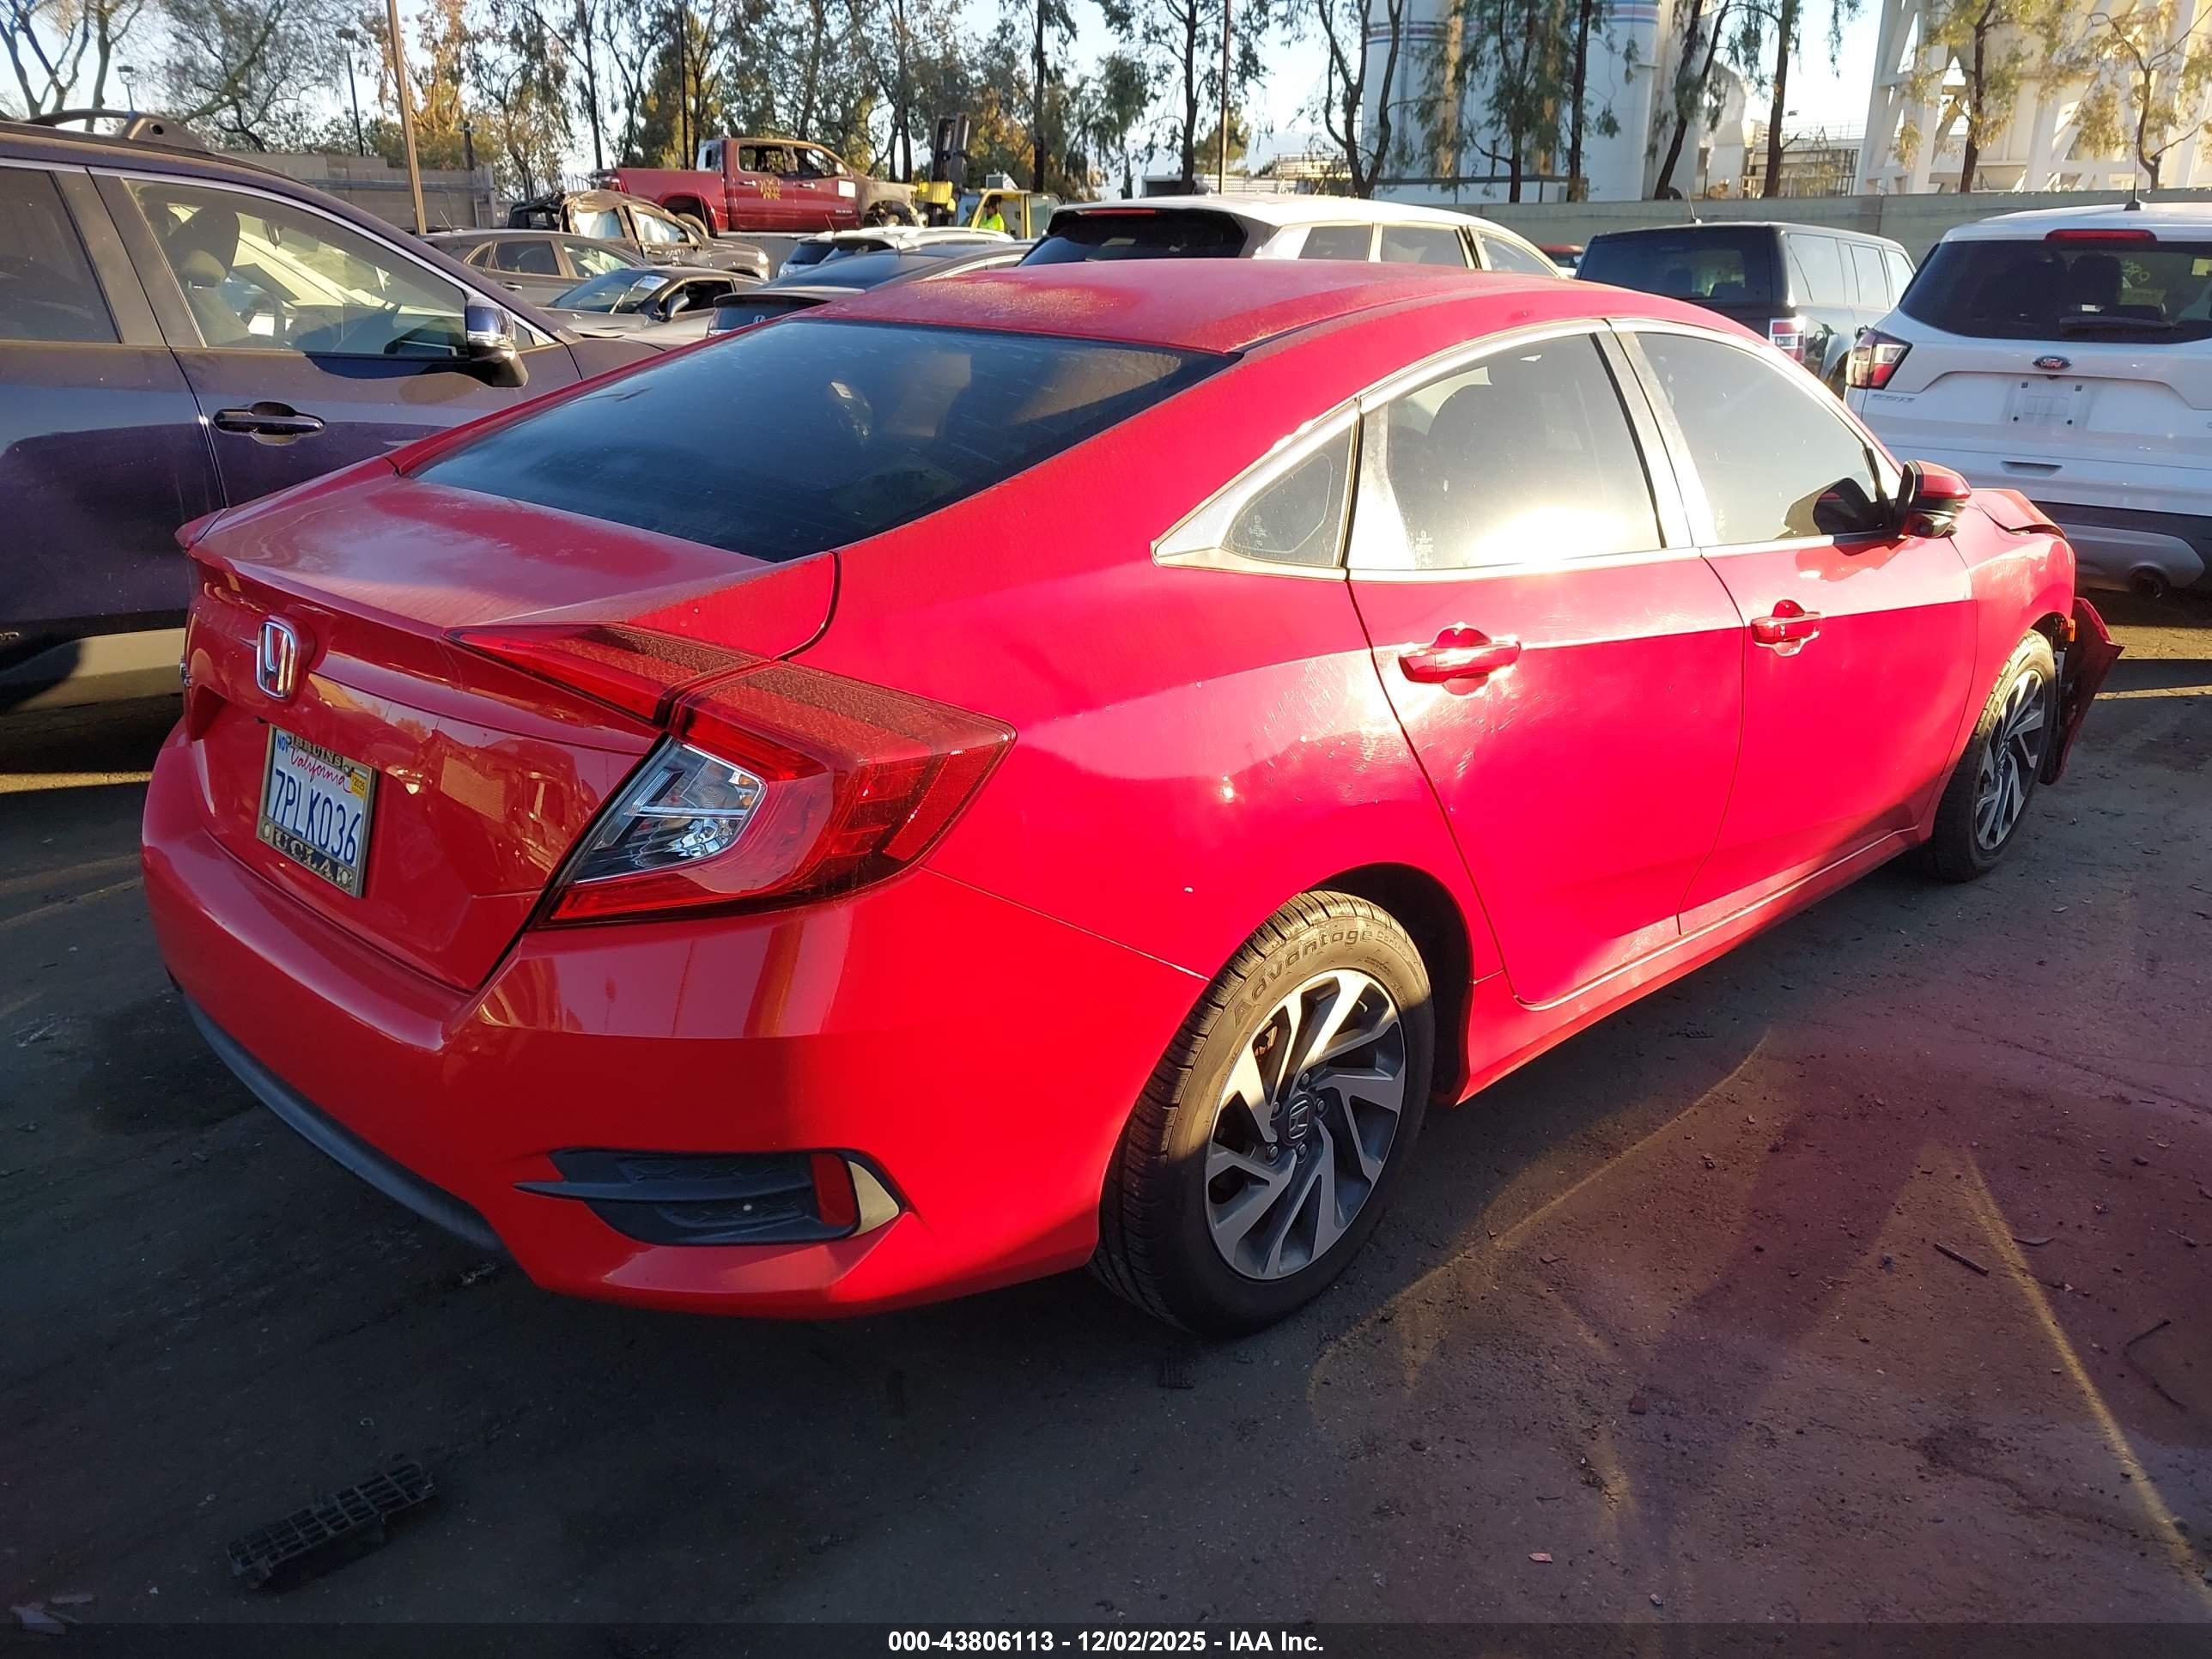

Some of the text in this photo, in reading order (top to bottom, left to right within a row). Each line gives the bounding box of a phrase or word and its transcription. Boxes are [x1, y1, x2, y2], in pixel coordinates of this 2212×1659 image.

[290, 745, 351, 793] California
[295, 736, 343, 767] BRUINS
[273, 768, 362, 865] 7PLK036
[276, 829, 333, 880] UCLA
[1235, 927, 1373, 1029] Advantage
